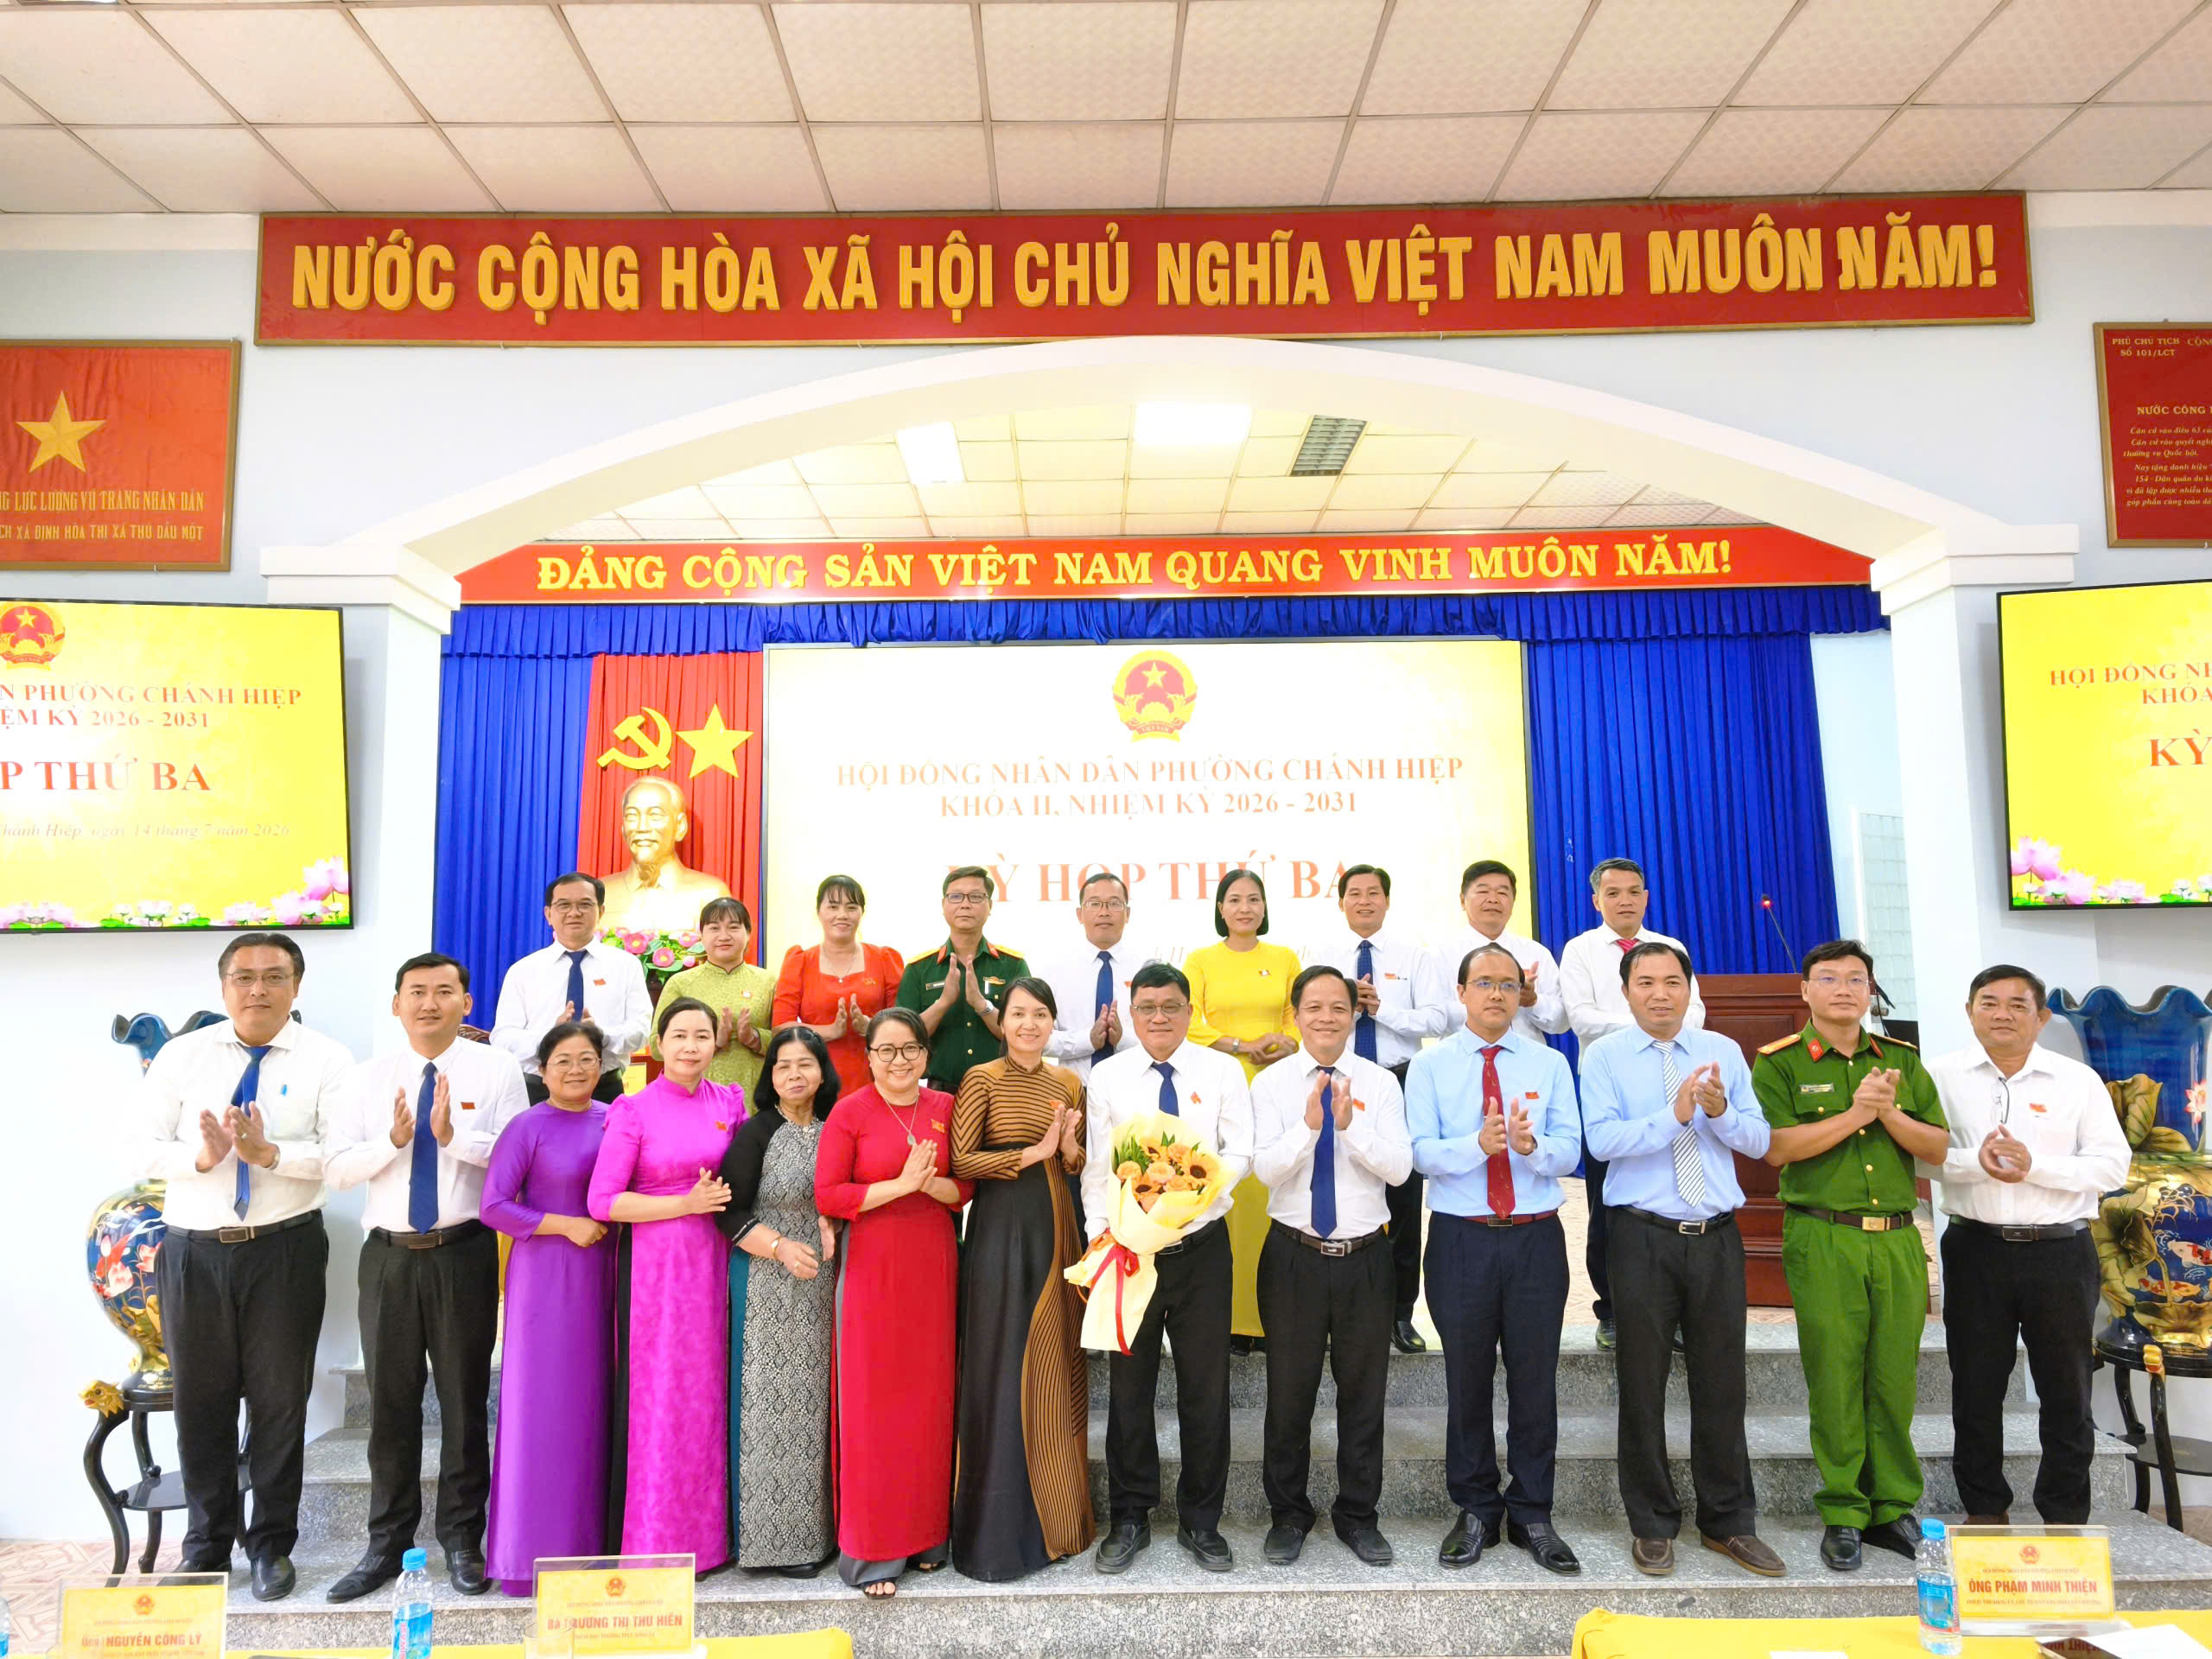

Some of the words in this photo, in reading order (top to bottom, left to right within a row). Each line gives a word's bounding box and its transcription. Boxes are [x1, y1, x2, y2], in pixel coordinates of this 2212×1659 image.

[293, 229, 454, 311] NƯỚC
[478, 231, 639, 325] CỘNG
[661, 232, 781, 312] HÒA
[803, 234, 878, 310] XÃ
[899, 230, 993, 323] HỘI
[1014, 222, 1129, 307] CHỦ
[1156, 229, 1330, 306] NGHĨA
[1345, 224, 1472, 315] VIỆT
[1495, 232, 1624, 299] NAM
[1649, 213, 1823, 294] MUÔN
[1837, 211, 1998, 291] NĂM!
[2120, 346, 2133, 356] SỐ
[2137, 404, 2170, 415] NƯỚC
[2173, 404, 2206, 416] CỘNG
[99, 490, 140, 511] TRANG
[537, 545, 667, 590] ĐẢNG
[683, 547, 808, 596] CỘNG
[824, 543, 913, 588] SẢN
[928, 544, 1038, 594] VIỆT
[1053, 552, 1154, 586] NAM
[1166, 549, 1323, 591] QUANG
[1338, 548, 1452, 581] VINH
[1468, 537, 1599, 579] MUÔN
[1615, 533, 1732, 576] NĂM!
[2050, 665, 2094, 689] HỘI
[25, 680, 135, 703] PHƯỜNG
[143, 682, 233, 704] CHÁNH
[244, 686, 302, 709] HIỆP
[48, 705, 82, 726] KỲ
[92, 710, 140, 727] 2026
[162, 711, 208, 728] 2031
[2149, 728, 2212, 767] KỲ
[34, 753, 138, 791] THỨ
[150, 762, 211, 791] BA
[837, 761, 887, 791] HỘI
[991, 755, 1071, 784] NHÂN
[1083, 754, 1140, 783] DÂN
[1152, 753, 1273, 782] PHƯỜNG
[1283, 753, 1386, 780] CHÁNH
[1396, 754, 1463, 785] HIỆP
[940, 789, 1023, 817] KHÓA
[1070, 790, 1165, 820] NHIỆM
[1177, 786, 1214, 814] KỲ
[1224, 792, 1279, 813] 2026
[1305, 791, 1356, 812] 2031
[134, 823, 153, 837] 14
[253, 823, 290, 837] 2026
[1969, 1577, 1992, 1592] ÔNG
[1995, 1580, 2028, 1596] PHẠM
[2031, 1580, 2062, 1592] MINH
[633, 1615, 653, 1628] THU
